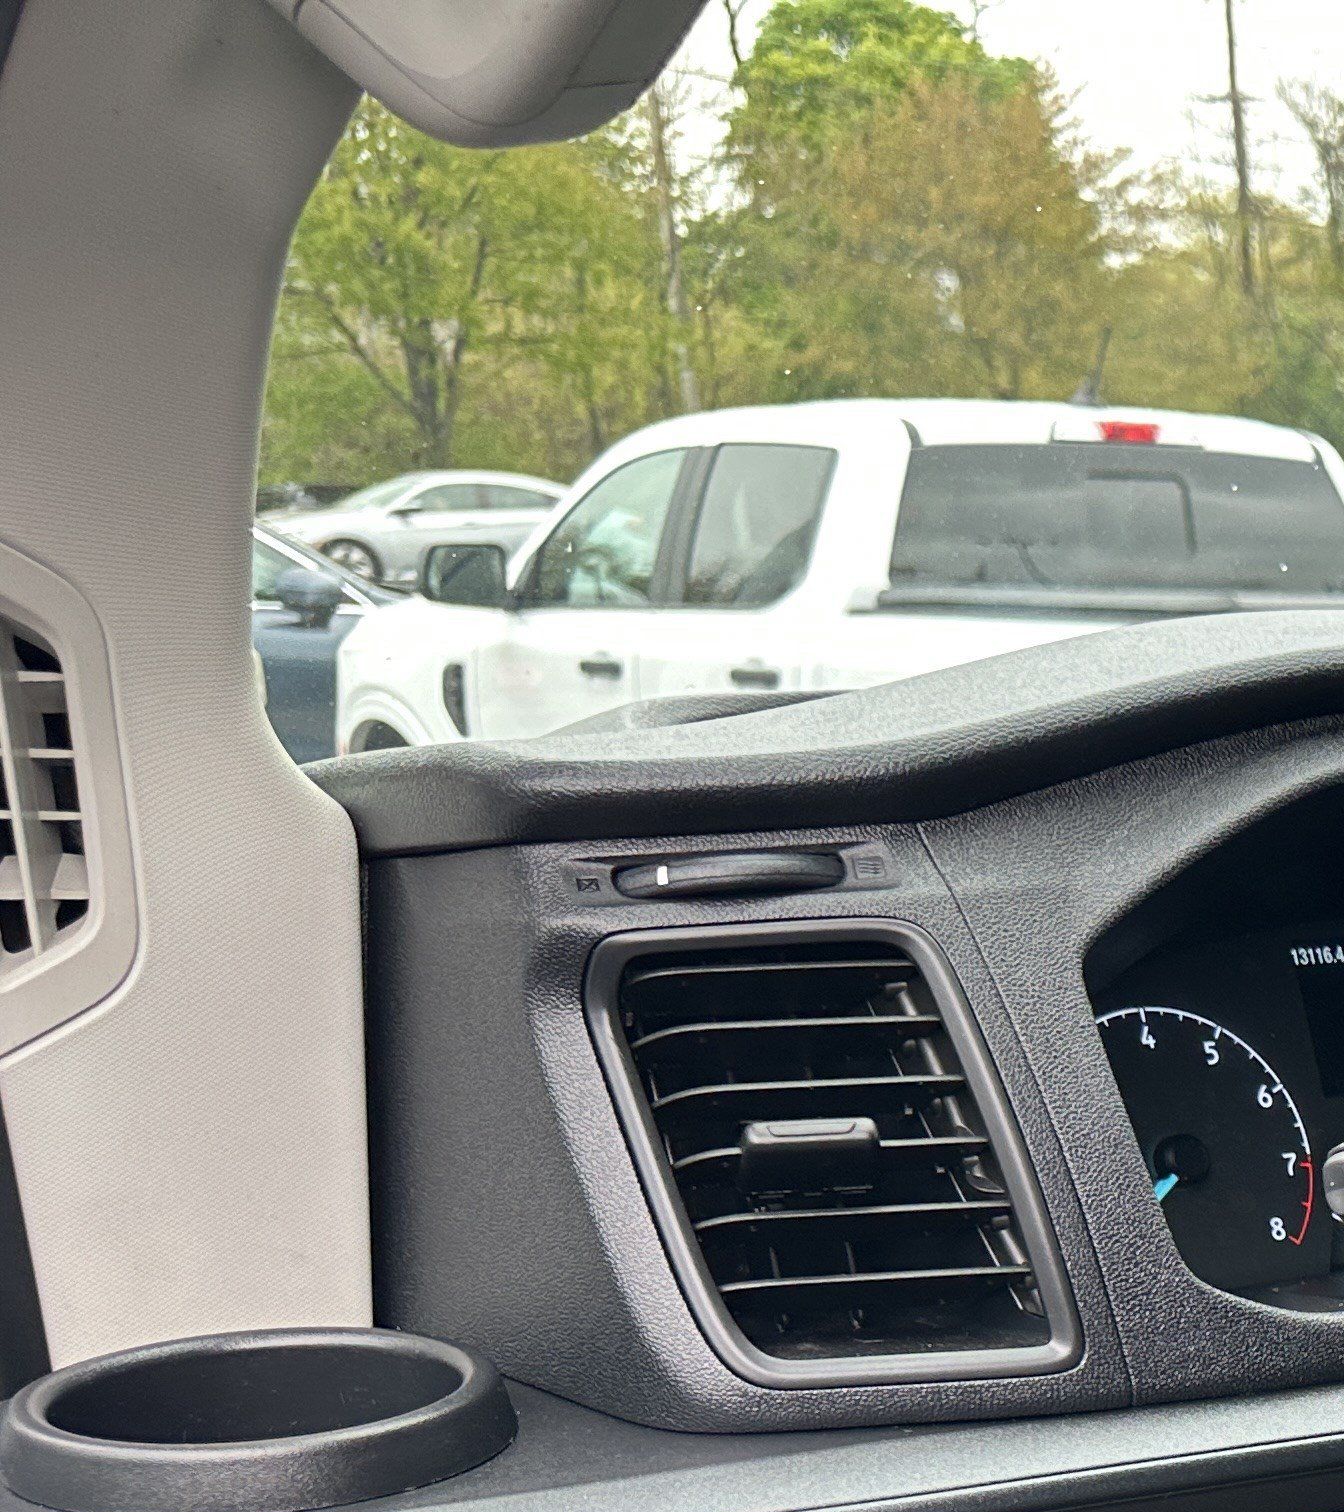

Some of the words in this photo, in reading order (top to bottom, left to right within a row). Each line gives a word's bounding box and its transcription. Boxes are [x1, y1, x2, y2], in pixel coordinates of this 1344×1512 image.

[1140, 1025, 1156, 1049] 4
[1203, 1041, 1220, 1066] 5
[1257, 1084, 1273, 1109] 6
[1281, 1152, 1297, 1177] 7
[1269, 1216, 1287, 1242] 8
